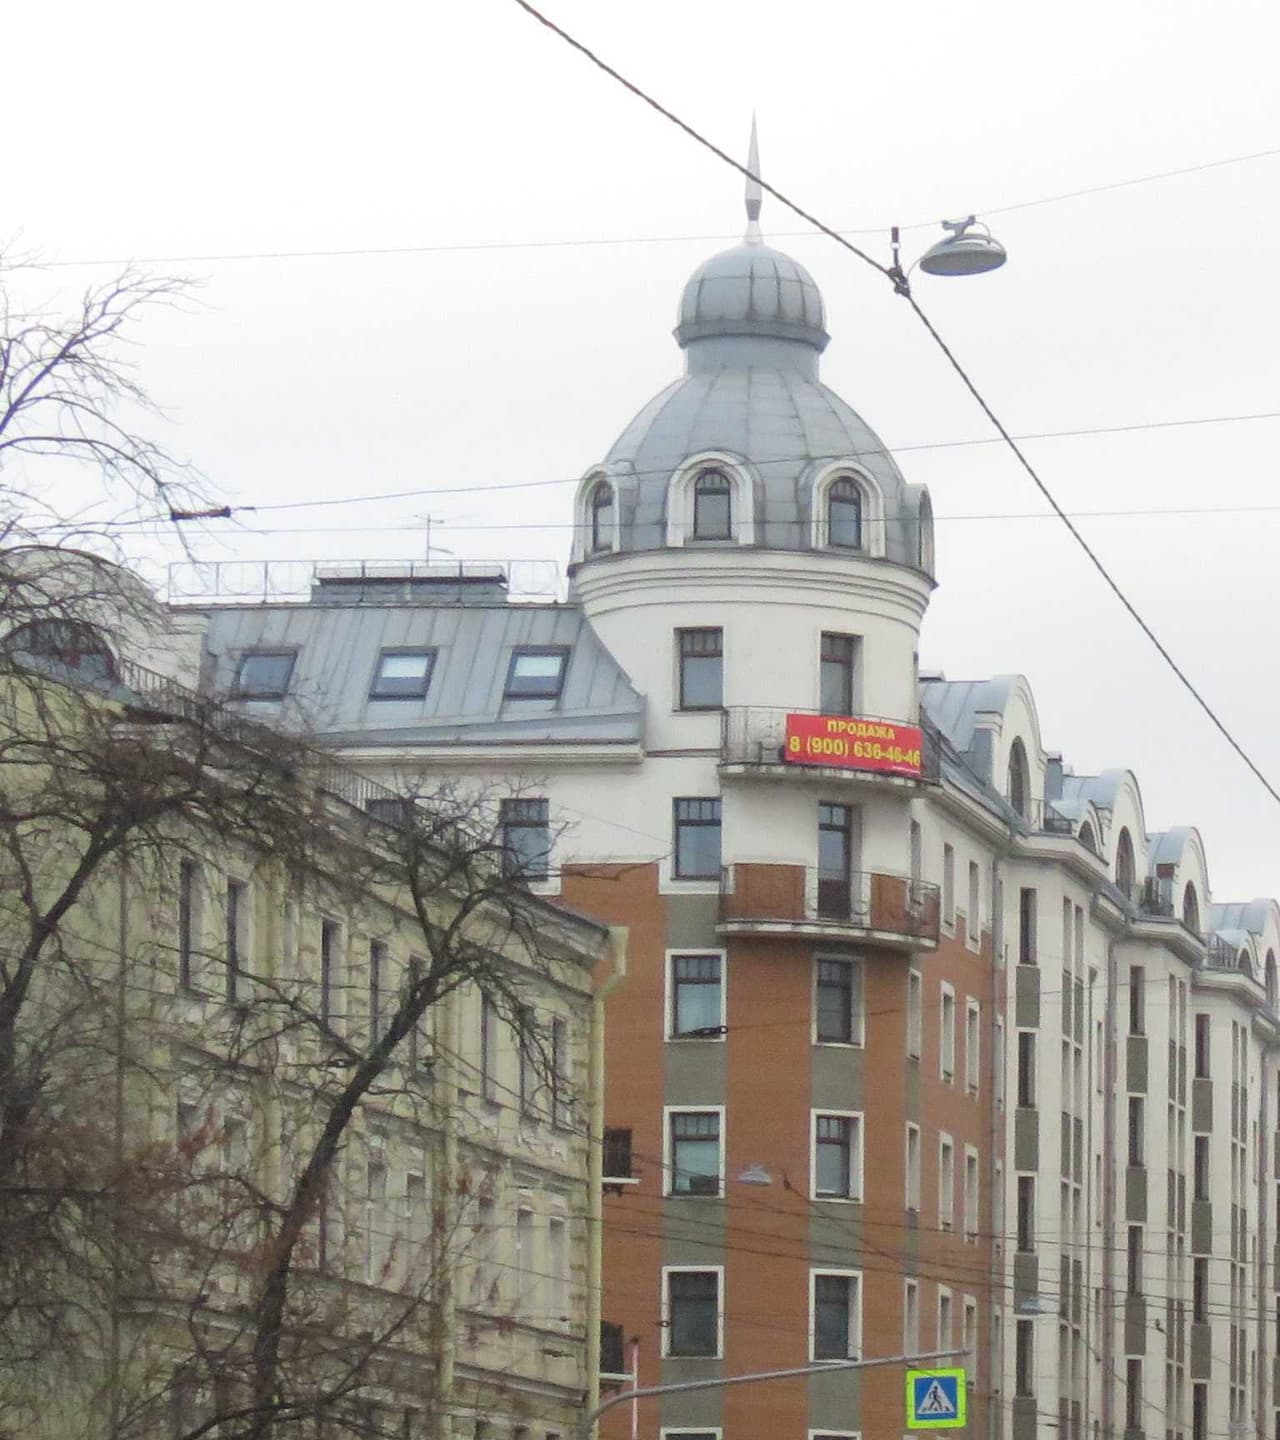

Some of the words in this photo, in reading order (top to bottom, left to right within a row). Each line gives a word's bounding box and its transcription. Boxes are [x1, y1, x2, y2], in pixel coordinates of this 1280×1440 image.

[827, 719, 896, 740] ПРОДАЖА
[789, 736, 801, 752] 8
[807, 736, 849, 757] (900)
